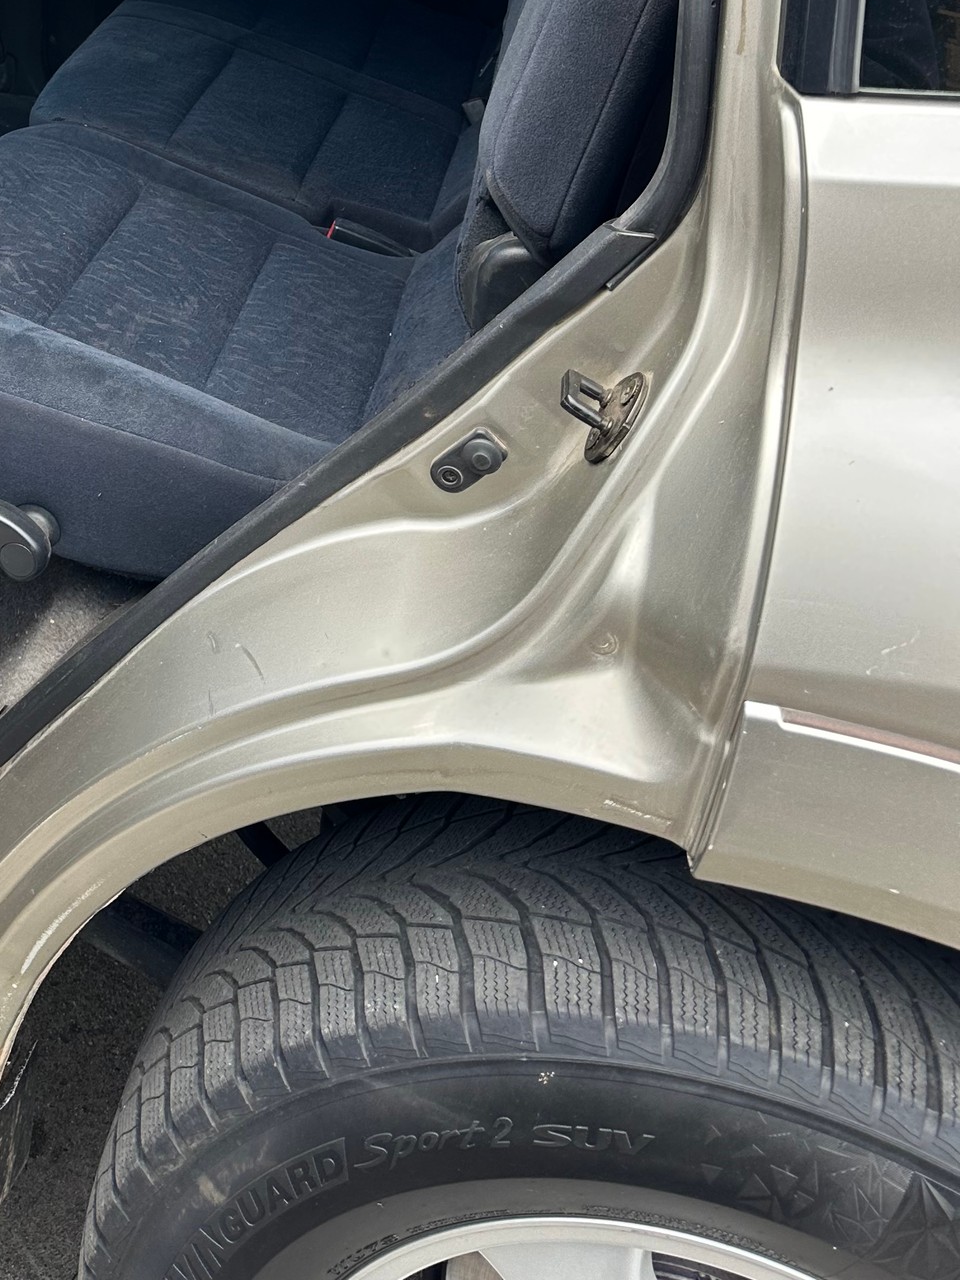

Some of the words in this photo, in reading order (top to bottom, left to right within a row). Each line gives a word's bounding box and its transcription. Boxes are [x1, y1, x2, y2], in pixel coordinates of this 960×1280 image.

[353, 1119, 486, 1169] Sport
[490, 1116, 514, 1150] 2
[532, 1123, 656, 1155] SUV
